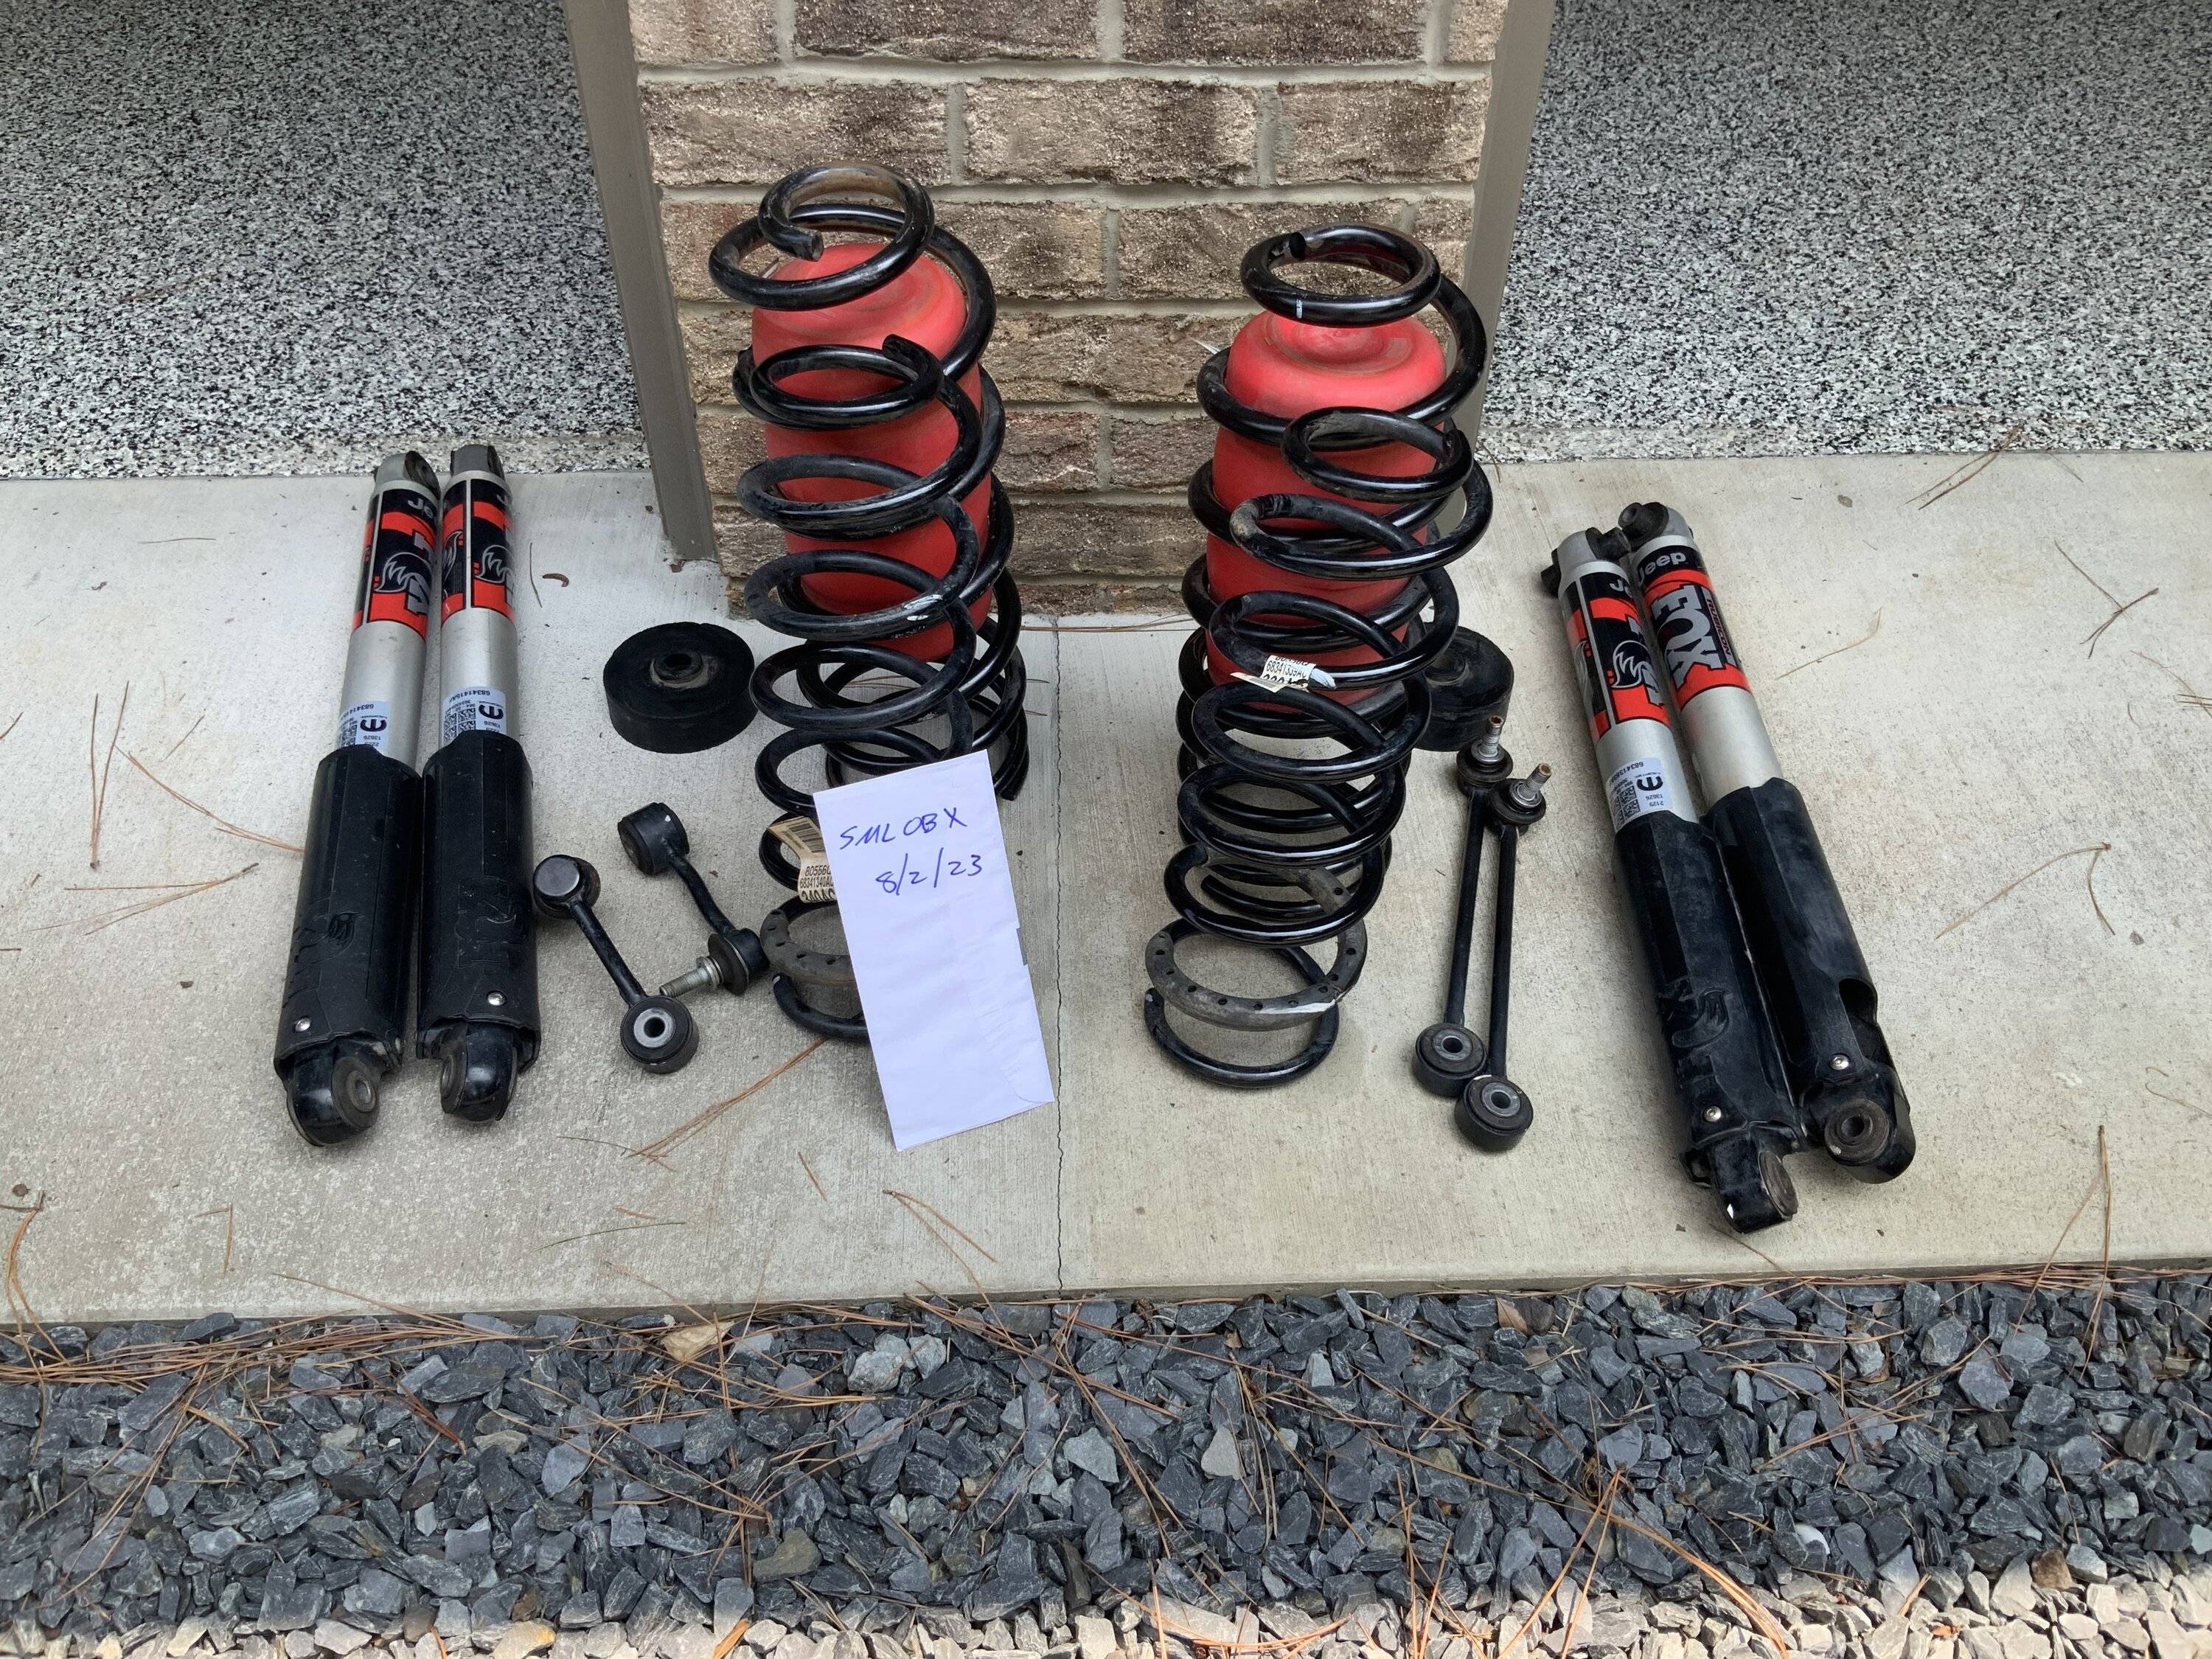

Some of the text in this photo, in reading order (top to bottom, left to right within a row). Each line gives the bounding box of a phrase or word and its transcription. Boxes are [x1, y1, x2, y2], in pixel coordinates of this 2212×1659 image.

[1638, 552, 1687, 586] Jeep
[1651, 585, 1724, 689] FOX
[1706, 598, 1731, 655] RUBICON
